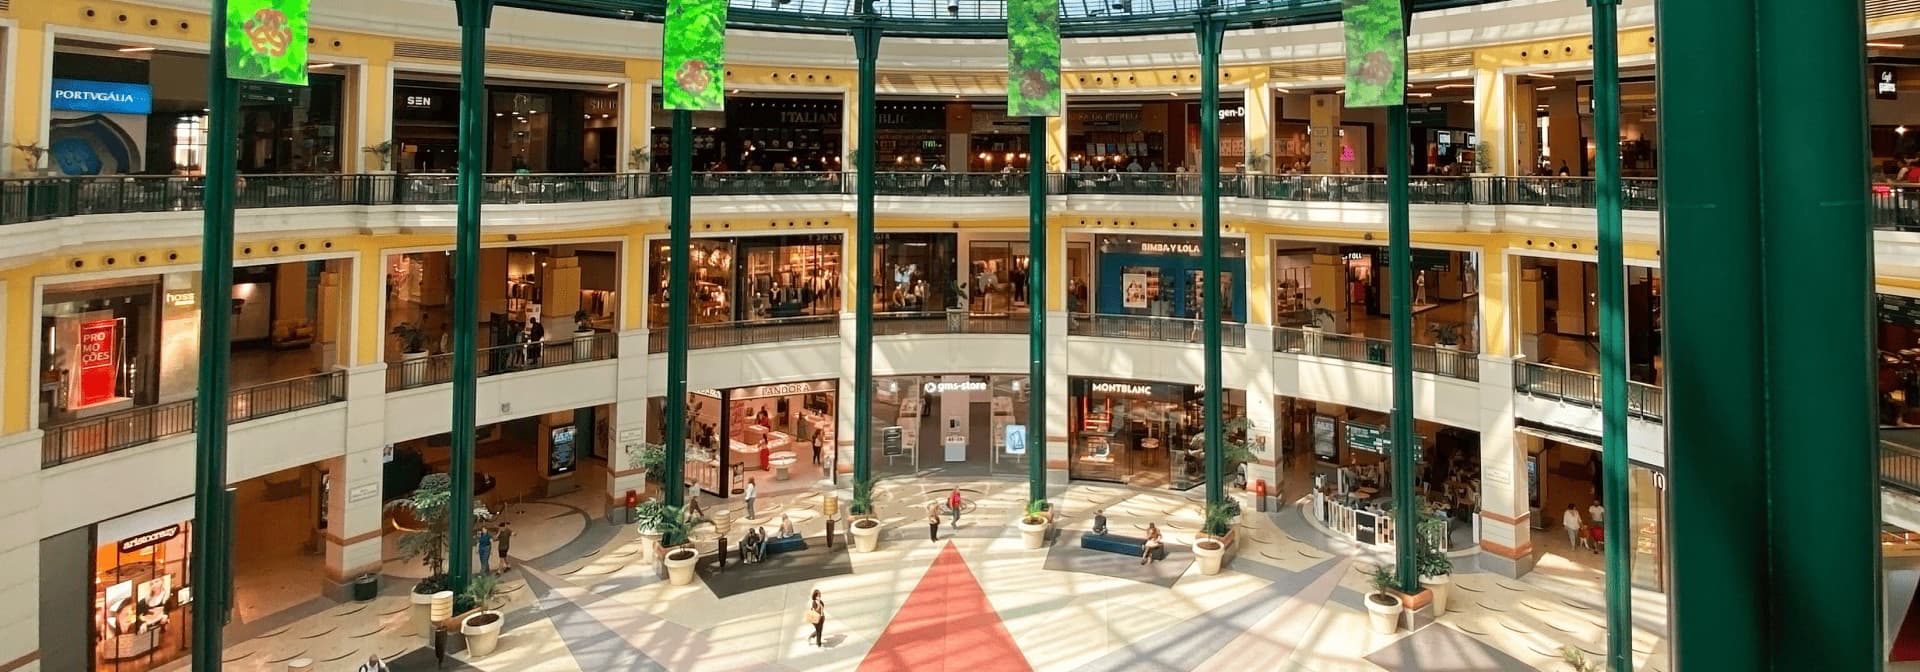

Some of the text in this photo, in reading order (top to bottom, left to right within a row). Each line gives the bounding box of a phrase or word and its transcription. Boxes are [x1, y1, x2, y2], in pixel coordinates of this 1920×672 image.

[407, 96, 431, 106] SEN
[780, 111, 838, 123] ITALIAN
[1141, 242, 1200, 253] BIMBA Y LOLA
[83, 331, 106, 343] PRO
[83, 342, 101, 353] MO
[762, 383, 810, 396] PANDORA
[937, 381, 987, 393] gms-store
[1092, 383, 1152, 395] MONTBLANC
[122, 526, 177, 550] aristocrazy
